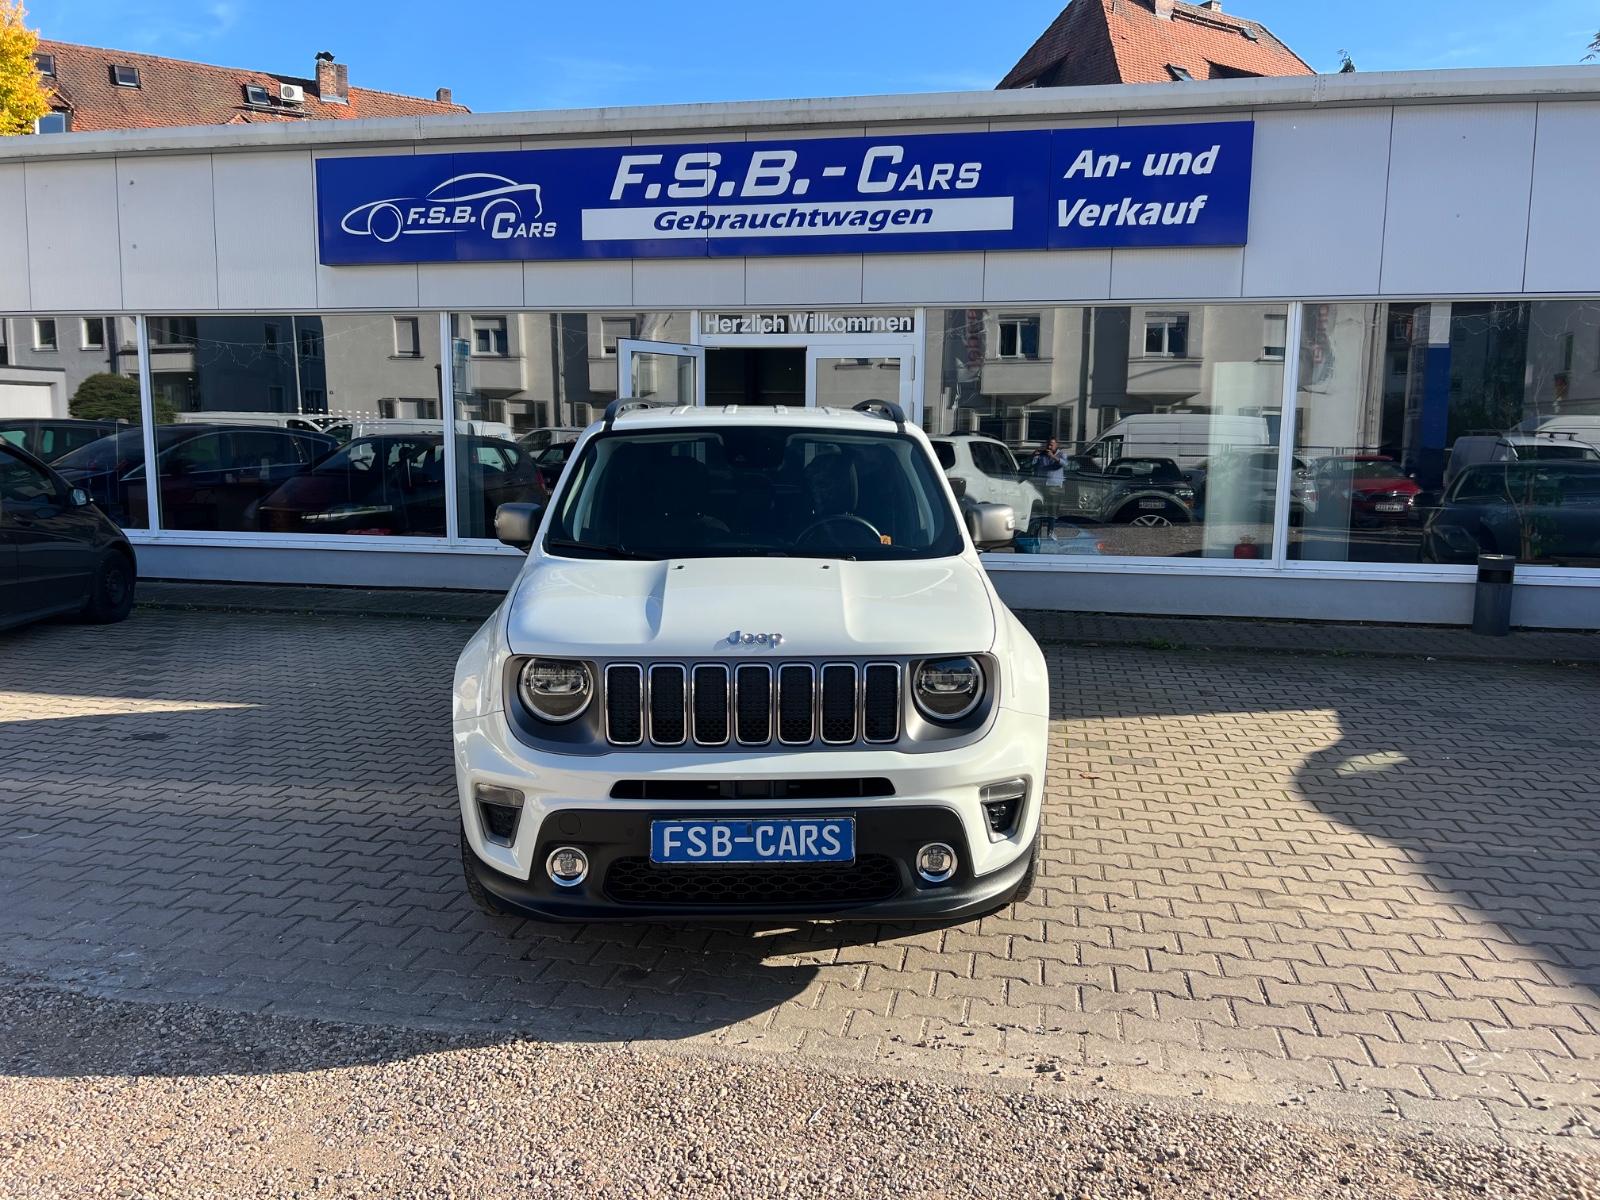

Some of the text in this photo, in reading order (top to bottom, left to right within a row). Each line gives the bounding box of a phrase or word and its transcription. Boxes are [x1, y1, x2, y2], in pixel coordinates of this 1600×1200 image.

[857, 145, 982, 194] CARS
[1064, 145, 1220, 179] An- und
[407, 206, 476, 225] F.S.B.
[654, 206, 933, 232] Gebrauchtwagen
[1057, 195, 1208, 228] Verkauf
[491, 212, 557, 239] CARS
[705, 313, 912, 334] Herzlich Willkommen
[728, 630, 782, 649] Jeep
[663, 824, 841, 857] FSB-CARS
